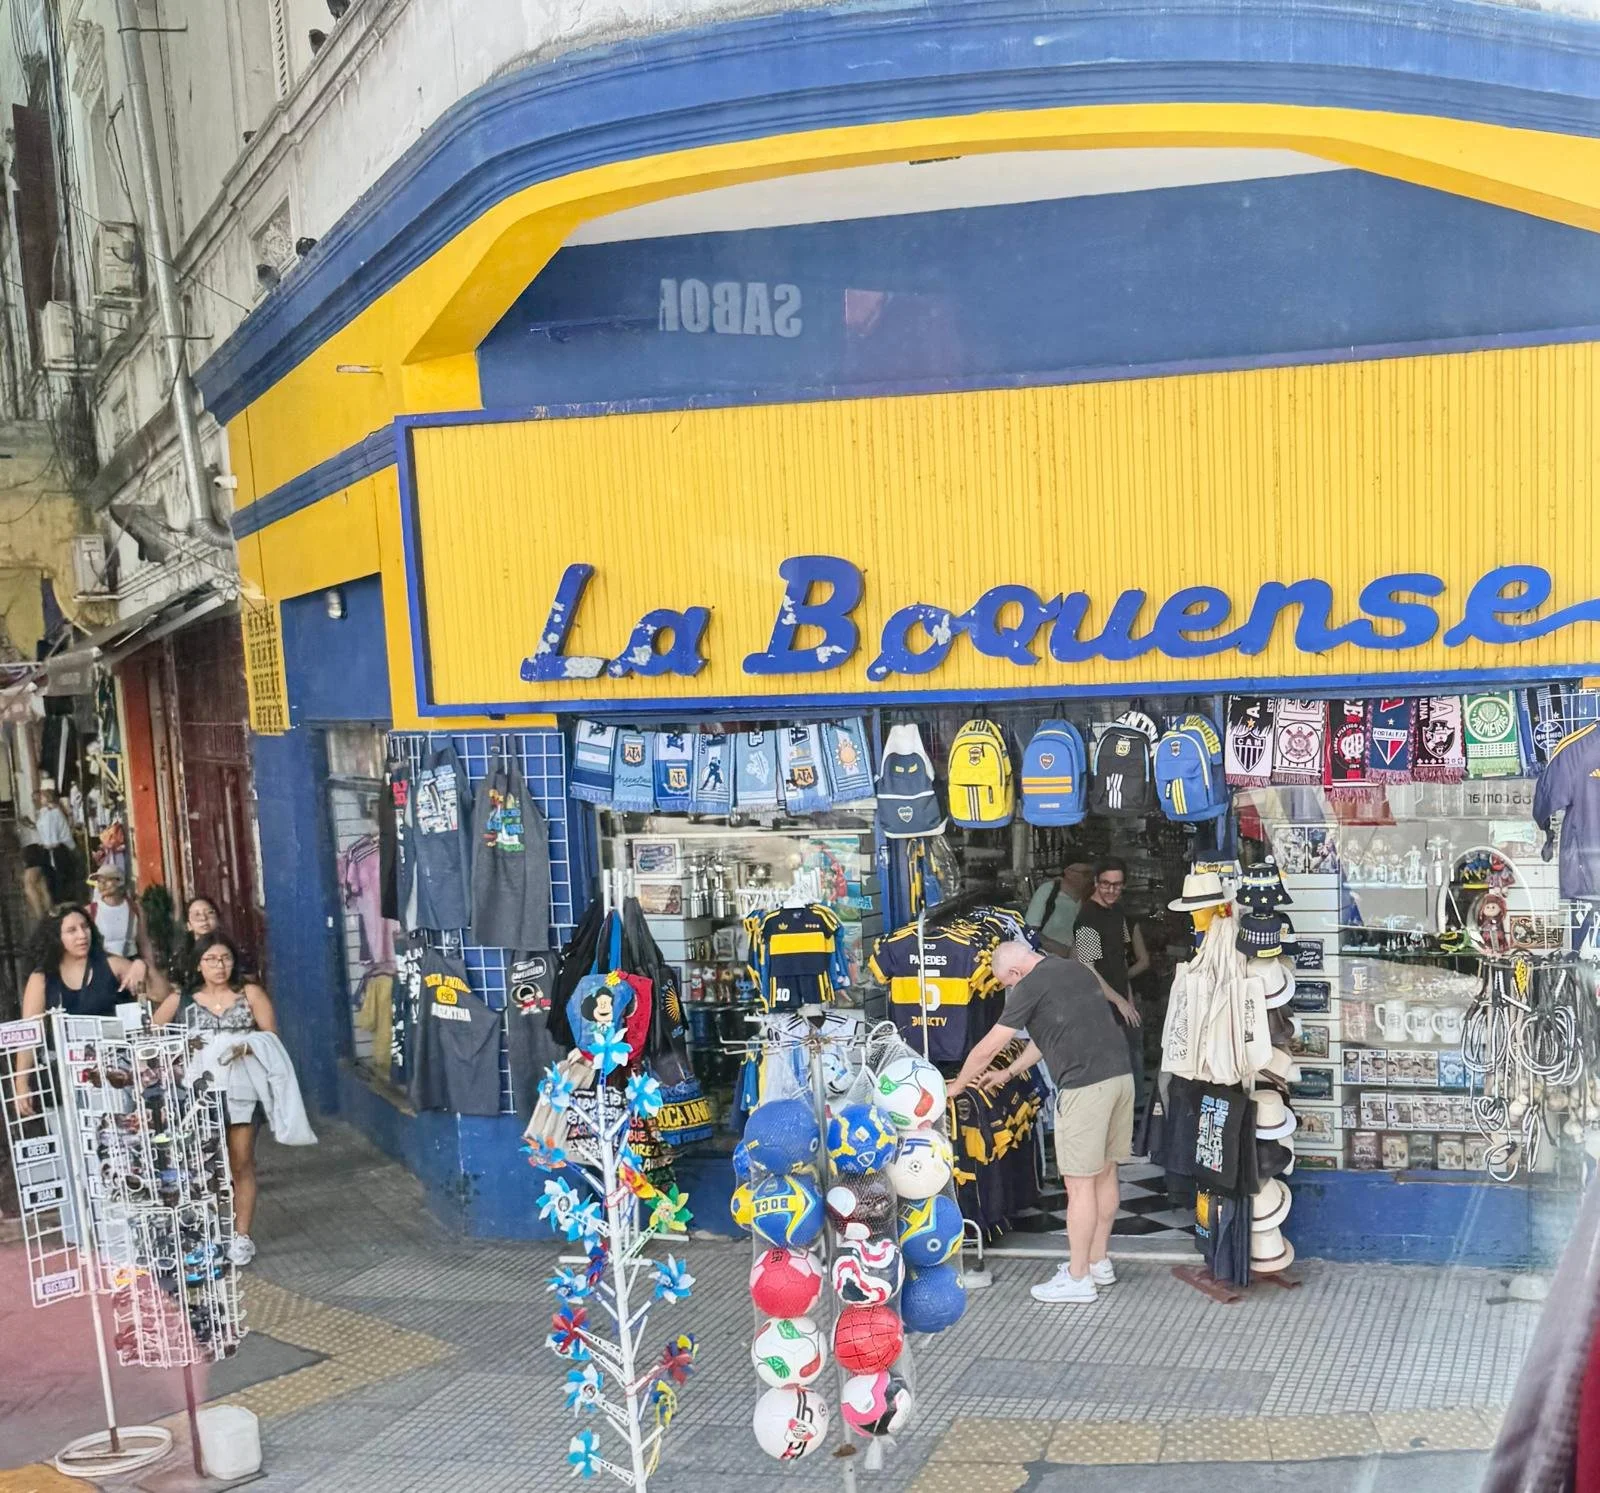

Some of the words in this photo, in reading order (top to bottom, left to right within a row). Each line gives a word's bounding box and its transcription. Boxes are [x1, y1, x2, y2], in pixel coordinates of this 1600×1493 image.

[520, 563, 712, 682] La
[1471, 712, 1509, 737] PALMEIRAS
[1373, 729, 1407, 738] FORTALEZA
[1237, 738, 1262, 746] CAM
[909, 954, 948, 966] PAEDES
[775, 988, 790, 1002] 10
[911, 1016, 948, 1027] DIECTV
